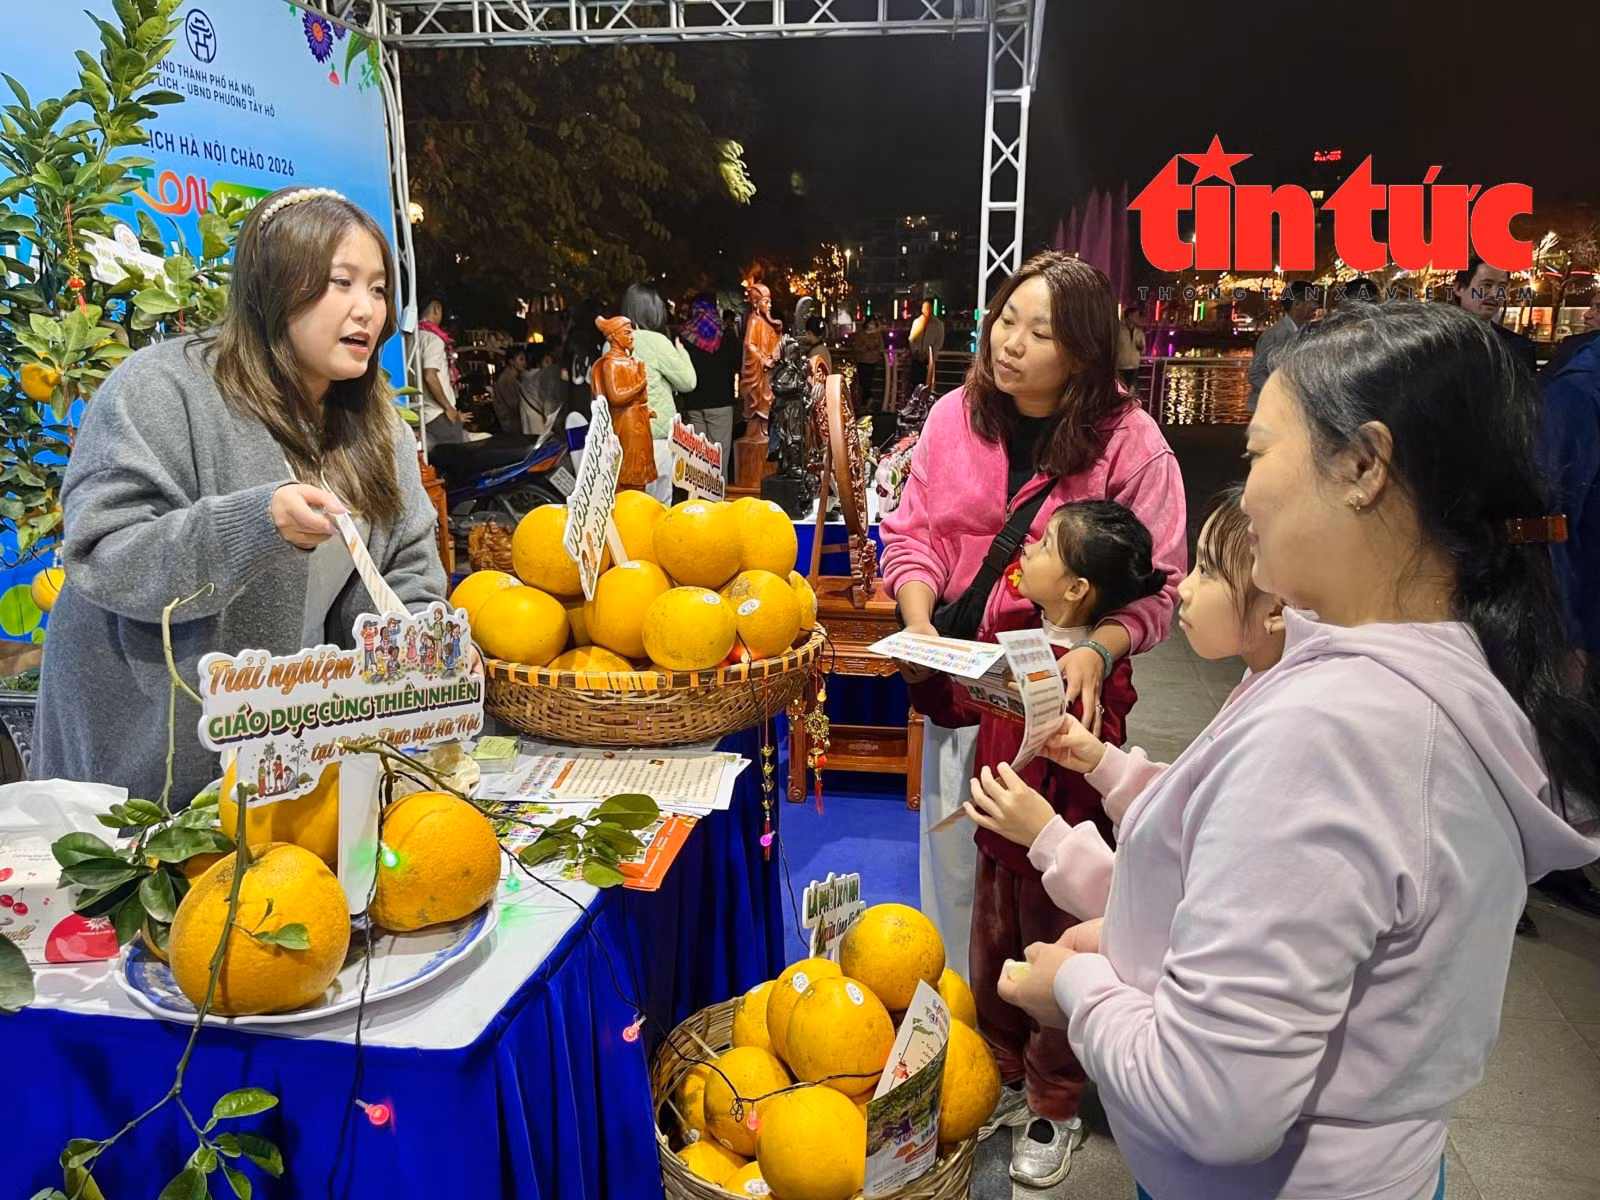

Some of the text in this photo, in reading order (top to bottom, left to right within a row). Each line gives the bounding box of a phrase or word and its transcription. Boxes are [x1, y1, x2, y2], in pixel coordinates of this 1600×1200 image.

[157, 60, 175, 74] BND
[187, 82, 211, 100] UBND
[142, 129, 294, 177] ỊCH HÀ NỘI CHÀO 2026
[208, 651, 355, 695] Trải nghiệm
[208, 677, 478, 738] GIÁO DỤC CÙNG THIÊN NHIÊN
